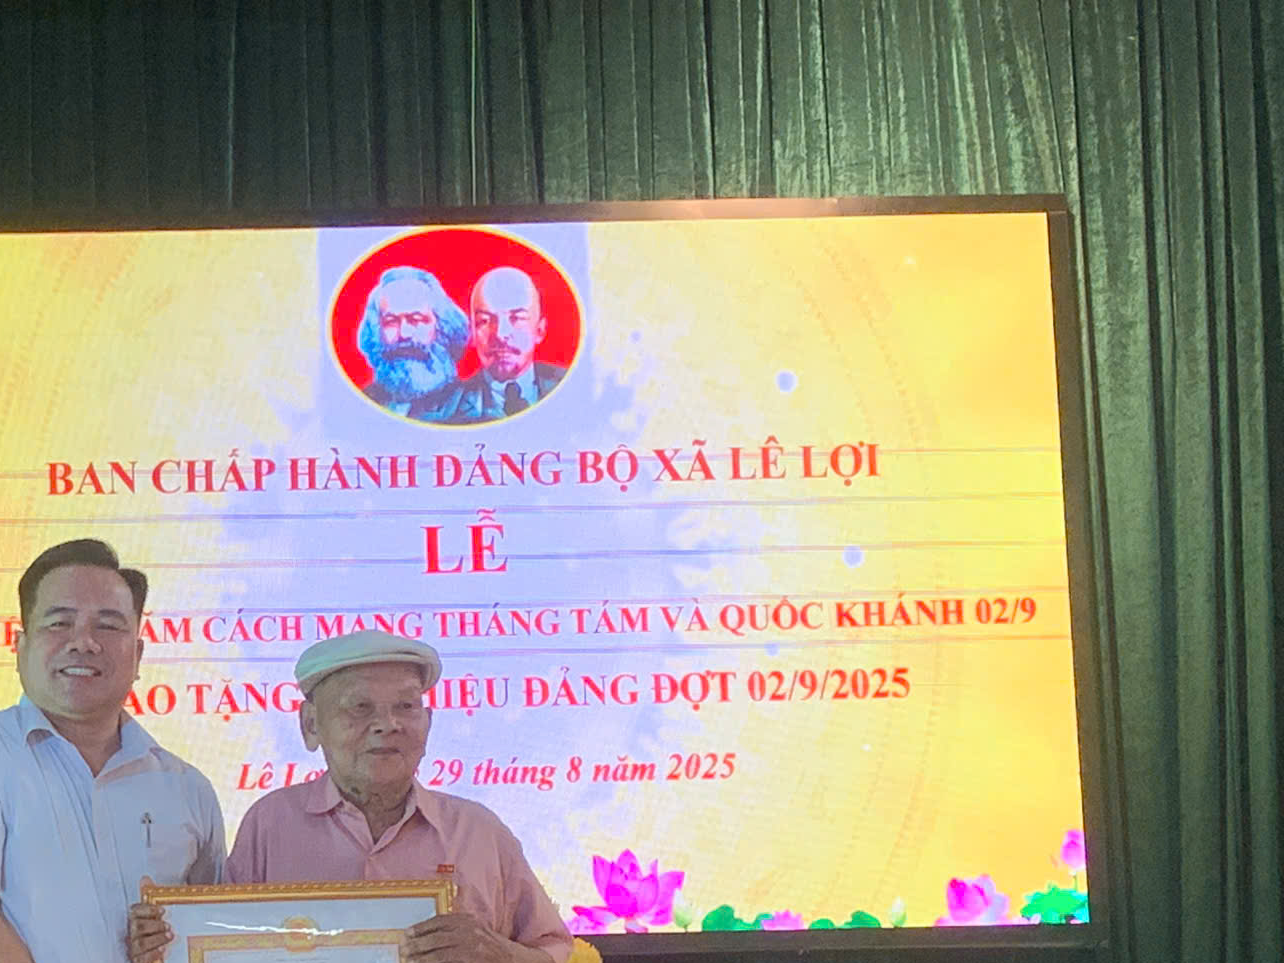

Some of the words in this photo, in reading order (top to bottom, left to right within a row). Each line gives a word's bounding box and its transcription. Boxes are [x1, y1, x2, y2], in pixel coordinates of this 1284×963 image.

[47, 461, 137, 496] BAN
[151, 447, 277, 493] CHẤP
[288, 447, 419, 491] HÀNH
[435, 443, 562, 488] ĐẢNG
[577, 444, 640, 492] BỘ
[652, 439, 716, 483] XÃ
[729, 435, 787, 480] LÊ
[802, 440, 881, 487] LỢI
[421, 507, 509, 574] LỄ
[201, 607, 303, 643] CÁCH
[434, 602, 560, 639] THÁNG
[571, 601, 651, 635] TÁM
[659, 600, 709, 632] VÀ
[718, 594, 824, 637] QUỐC
[835, 591, 966, 628] KHÁNH
[973, 596, 1038, 626] 02/9
[522, 665, 641, 708] ĐẢNG
[651, 668, 737, 712] ĐỢT
[746, 667, 912, 703] 02/9/2025
[236, 761, 275, 791] Lê
[427, 759, 465, 787] 29
[471, 753, 557, 791] tháng
[566, 756, 583, 783] 8
[592, 755, 657, 784] năm
[665, 752, 736, 781] 2025
